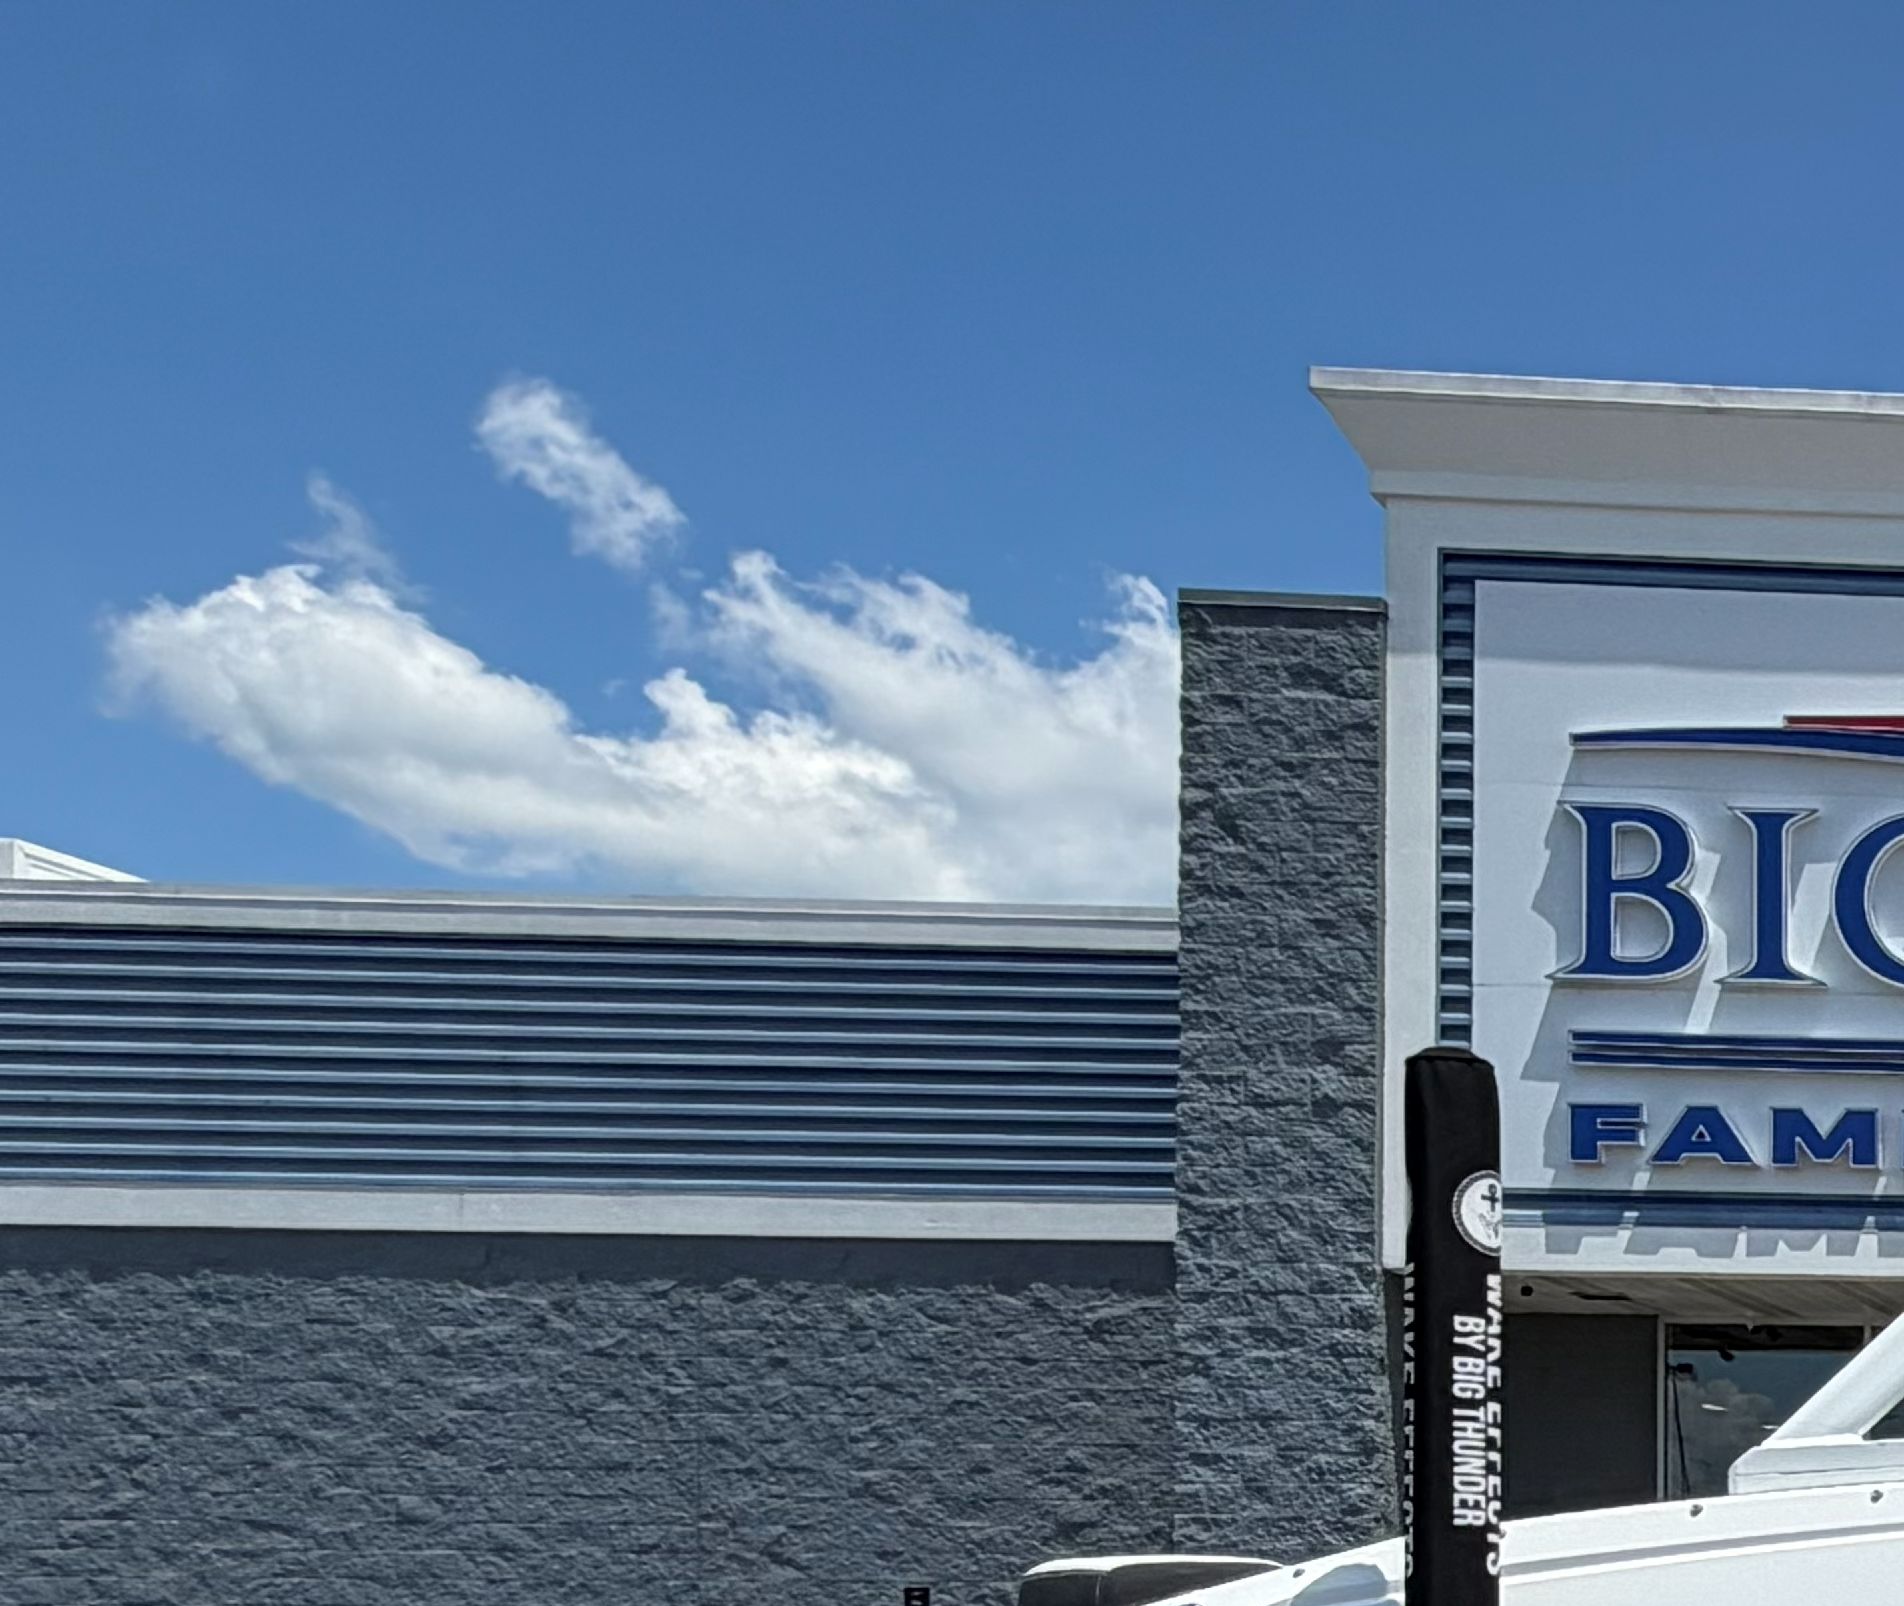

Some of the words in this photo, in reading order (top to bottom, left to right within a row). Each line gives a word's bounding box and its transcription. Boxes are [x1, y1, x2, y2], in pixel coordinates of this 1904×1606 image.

[1452, 1314, 1487, 1350] BY
[1452, 1356, 1487, 1399] BIG
[1452, 1406, 1487, 1528] THUNDER
